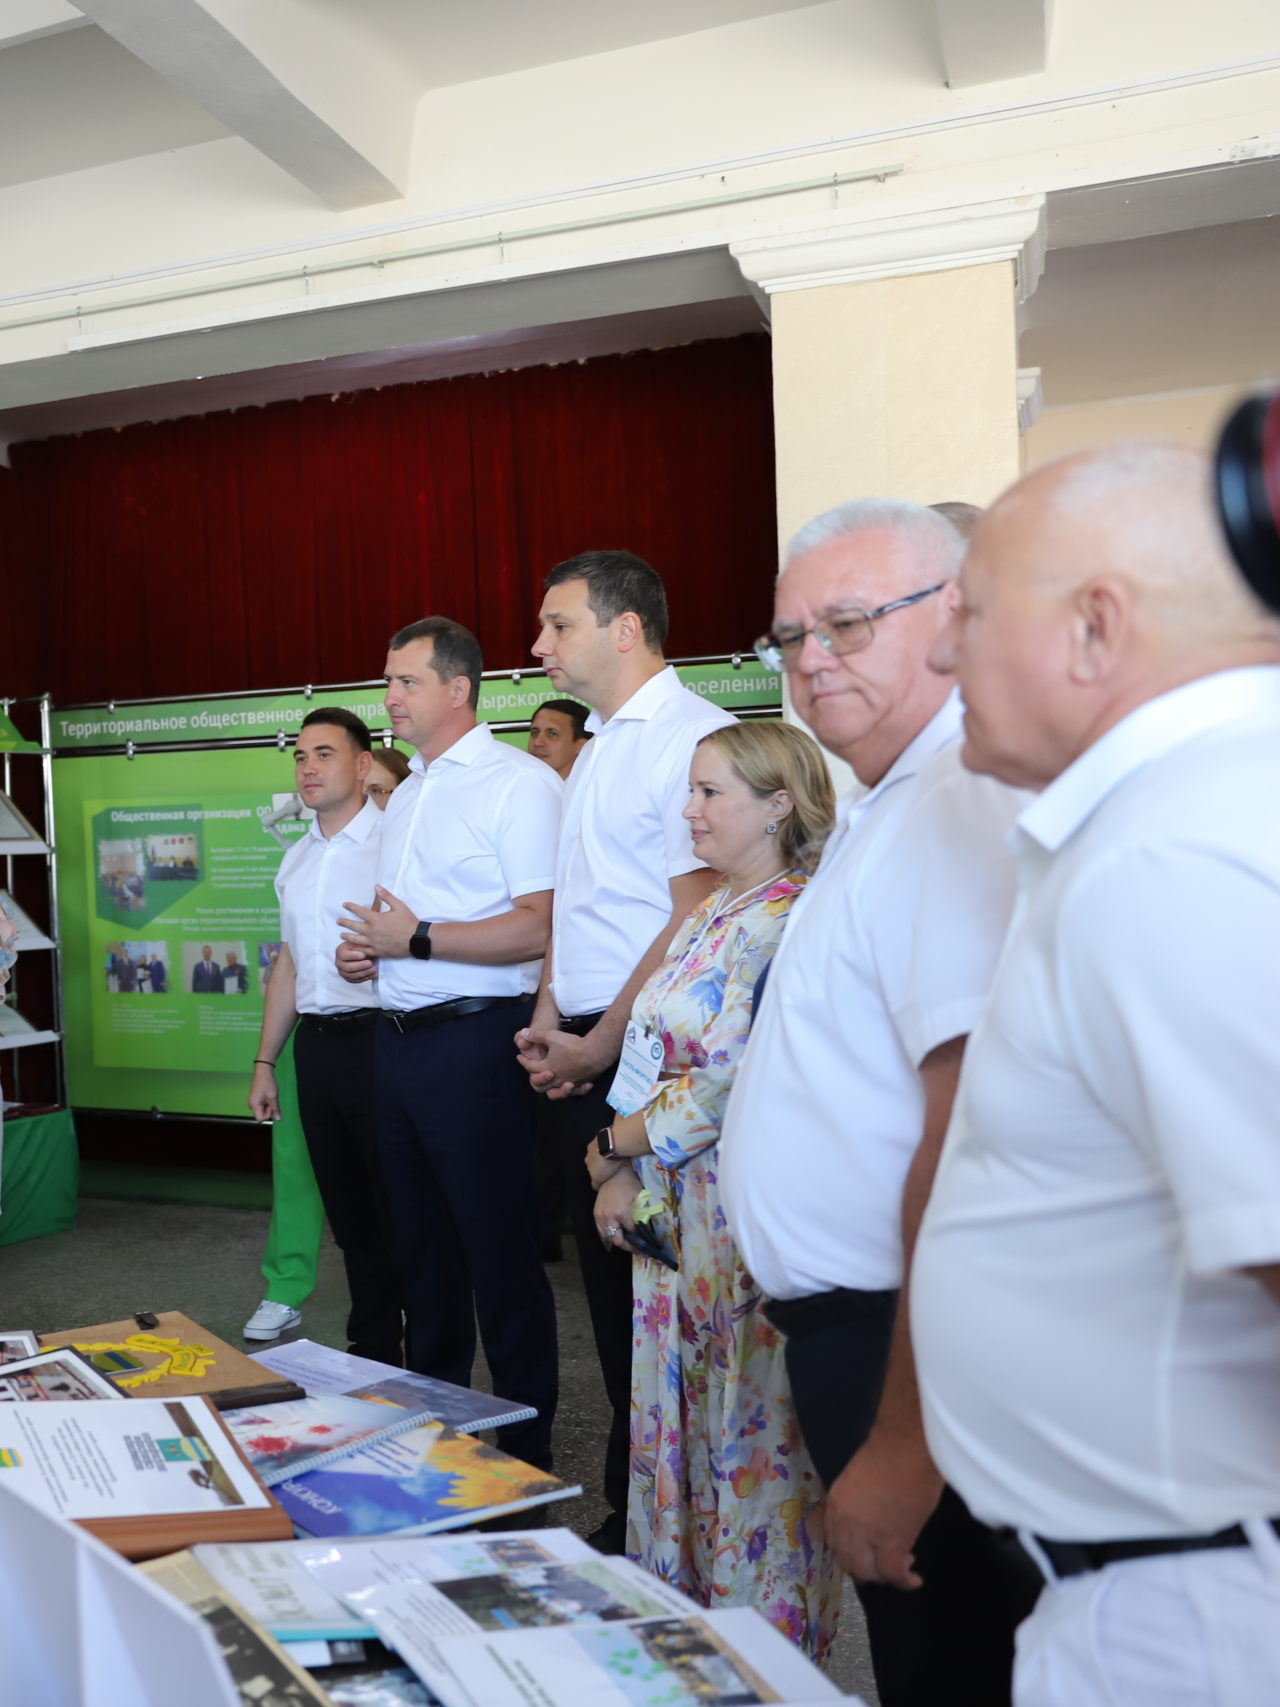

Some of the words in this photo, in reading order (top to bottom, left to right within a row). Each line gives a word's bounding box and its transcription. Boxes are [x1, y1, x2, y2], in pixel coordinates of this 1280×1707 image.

[60, 717, 186, 739] Территориальное
[191, 708, 303, 729] общественное
[686, 676, 778, 695] оселения
[111, 810, 185, 822] Общественная
[187, 808, 252, 822] организация
